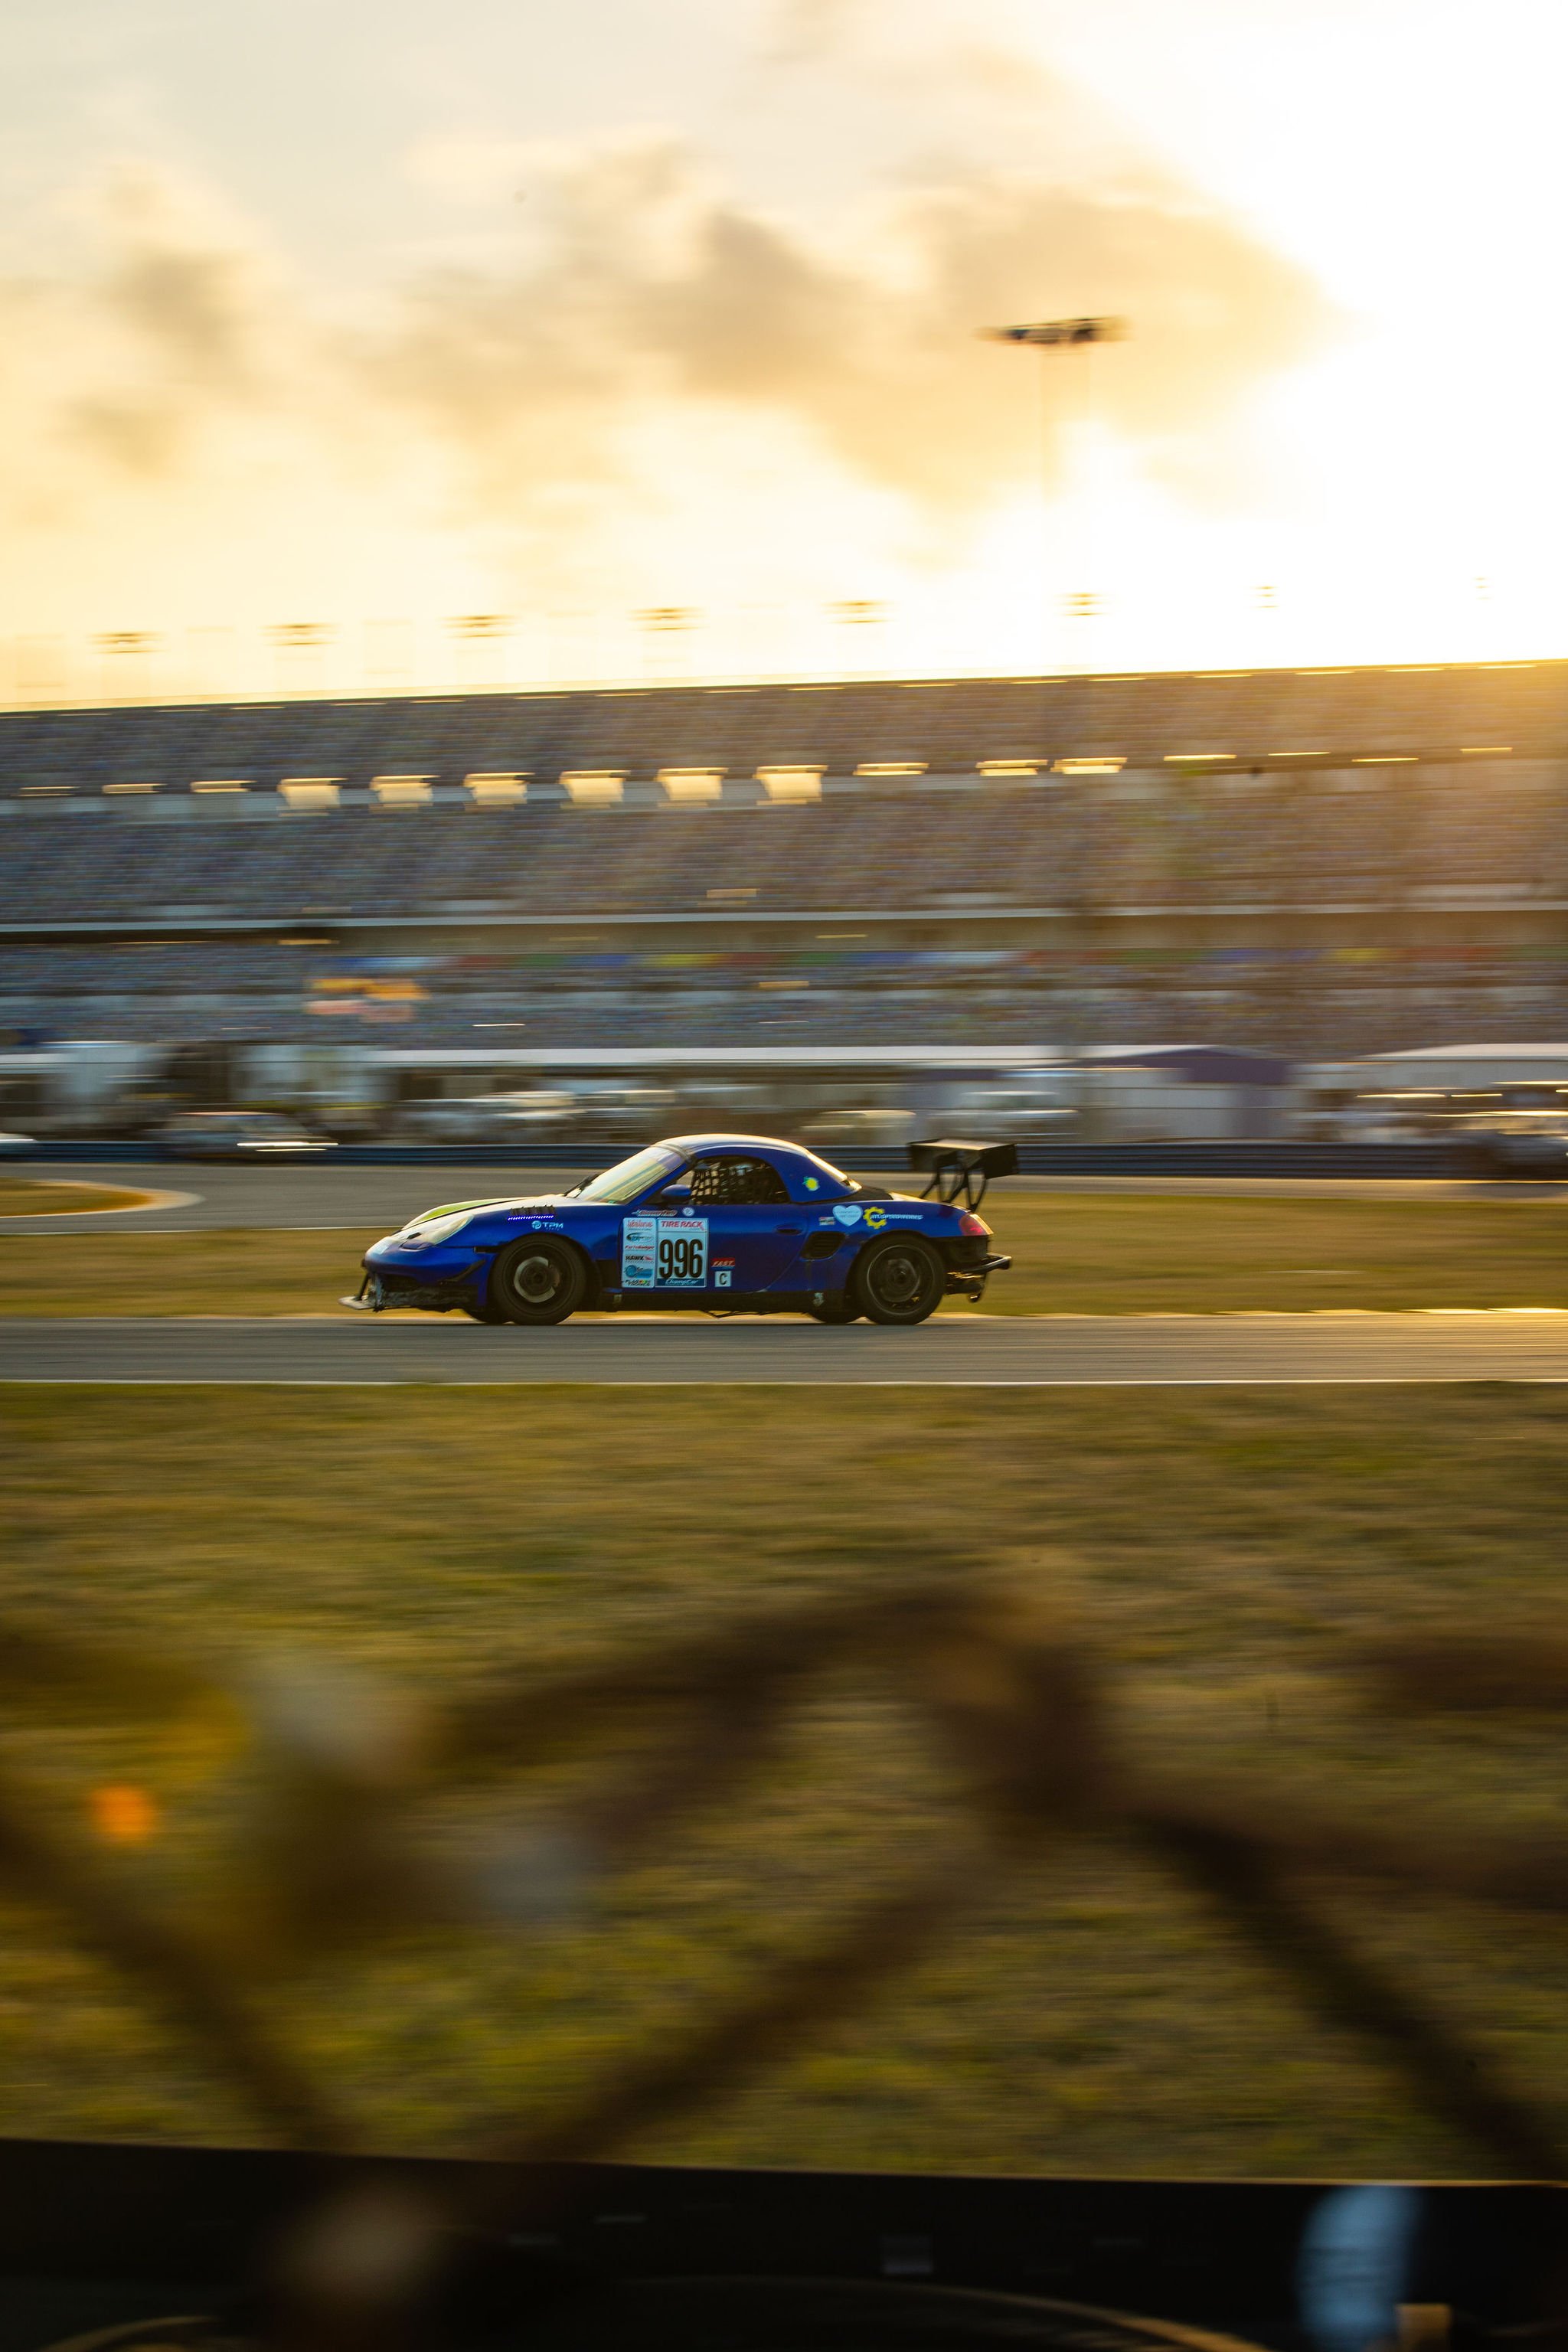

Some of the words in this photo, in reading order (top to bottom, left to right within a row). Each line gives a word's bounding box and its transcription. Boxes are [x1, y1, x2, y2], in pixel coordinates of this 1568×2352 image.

[681, 1220, 704, 1229] RACK
[659, 1239, 703, 1278] 996
[719, 1272, 727, 1285] C
